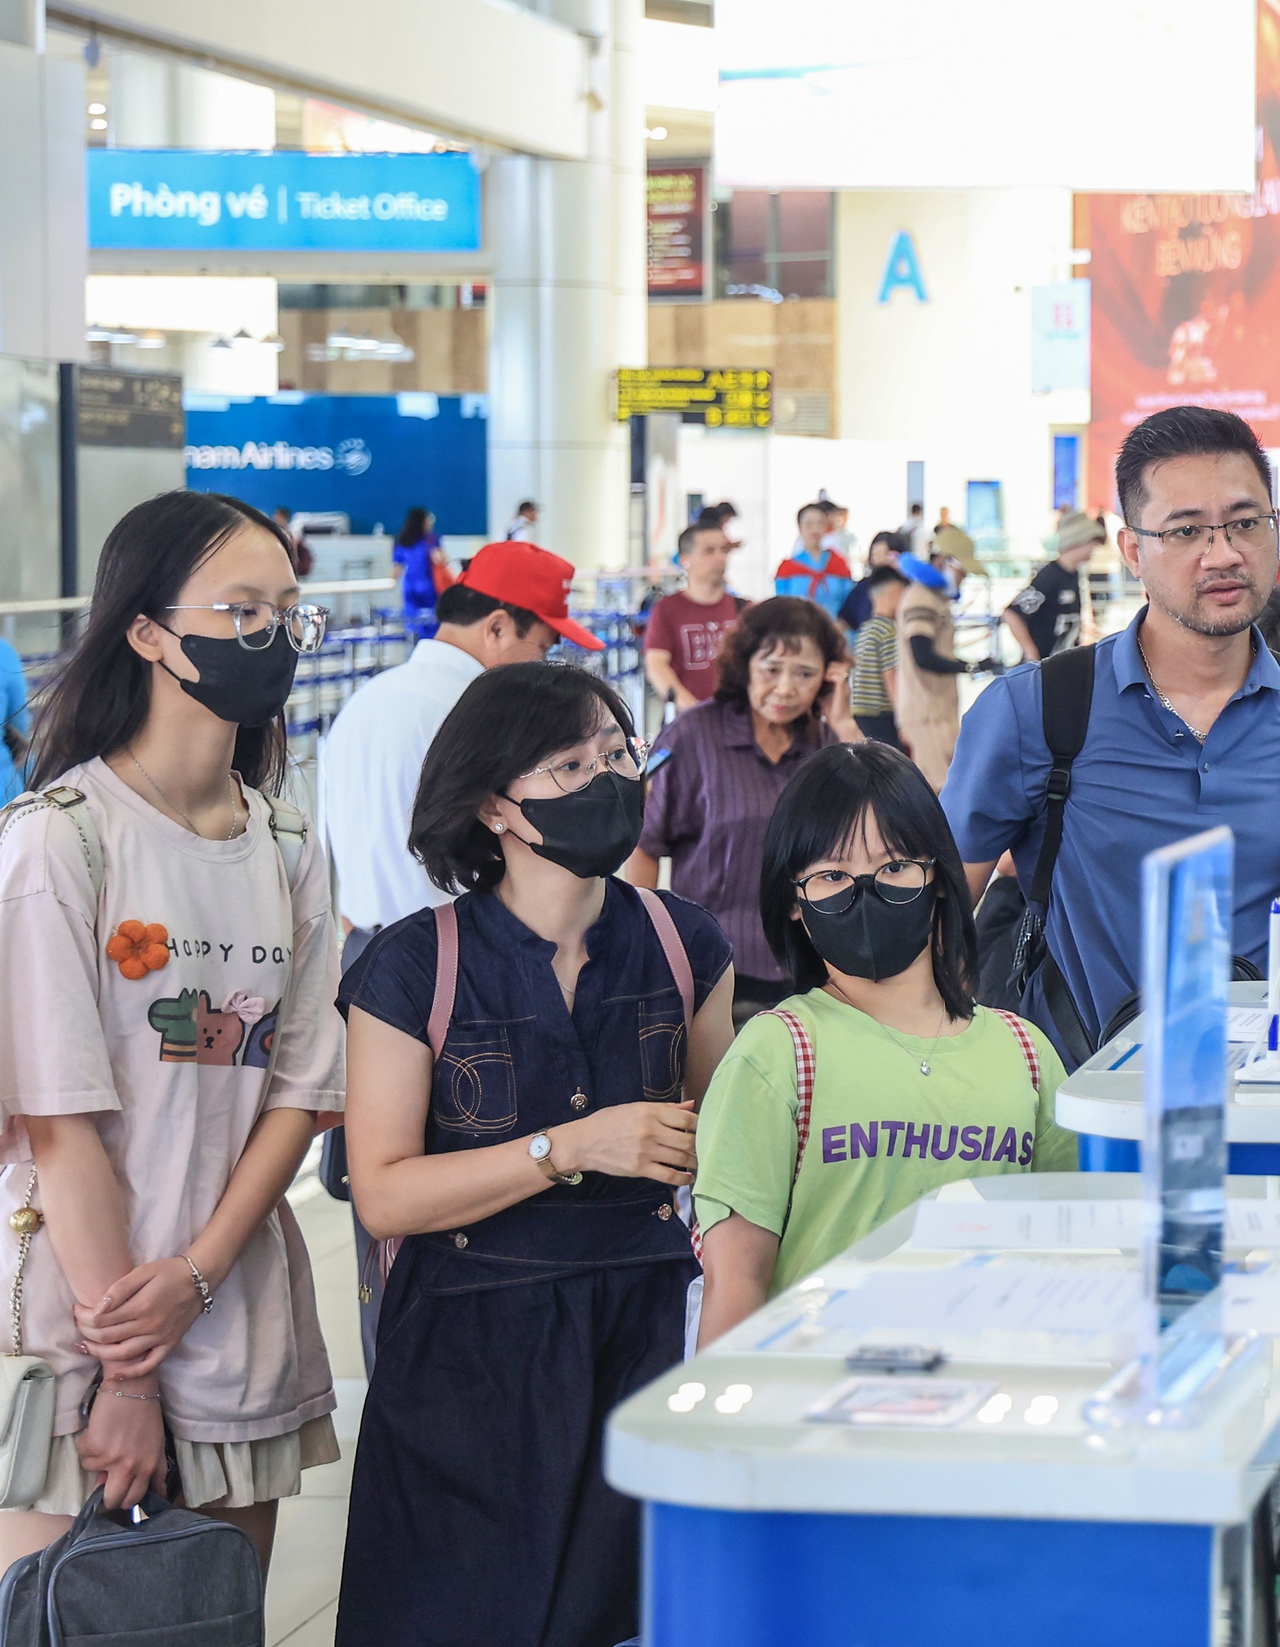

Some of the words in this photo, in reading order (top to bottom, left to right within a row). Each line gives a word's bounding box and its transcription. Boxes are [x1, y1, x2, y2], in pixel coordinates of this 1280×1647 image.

[109, 181, 222, 226] Phòng
[226, 183, 269, 219] vé
[296, 191, 371, 220] Ticket
[372, 190, 450, 221] Office
[876, 230, 929, 305] A
[241, 440, 335, 470] Airlines
